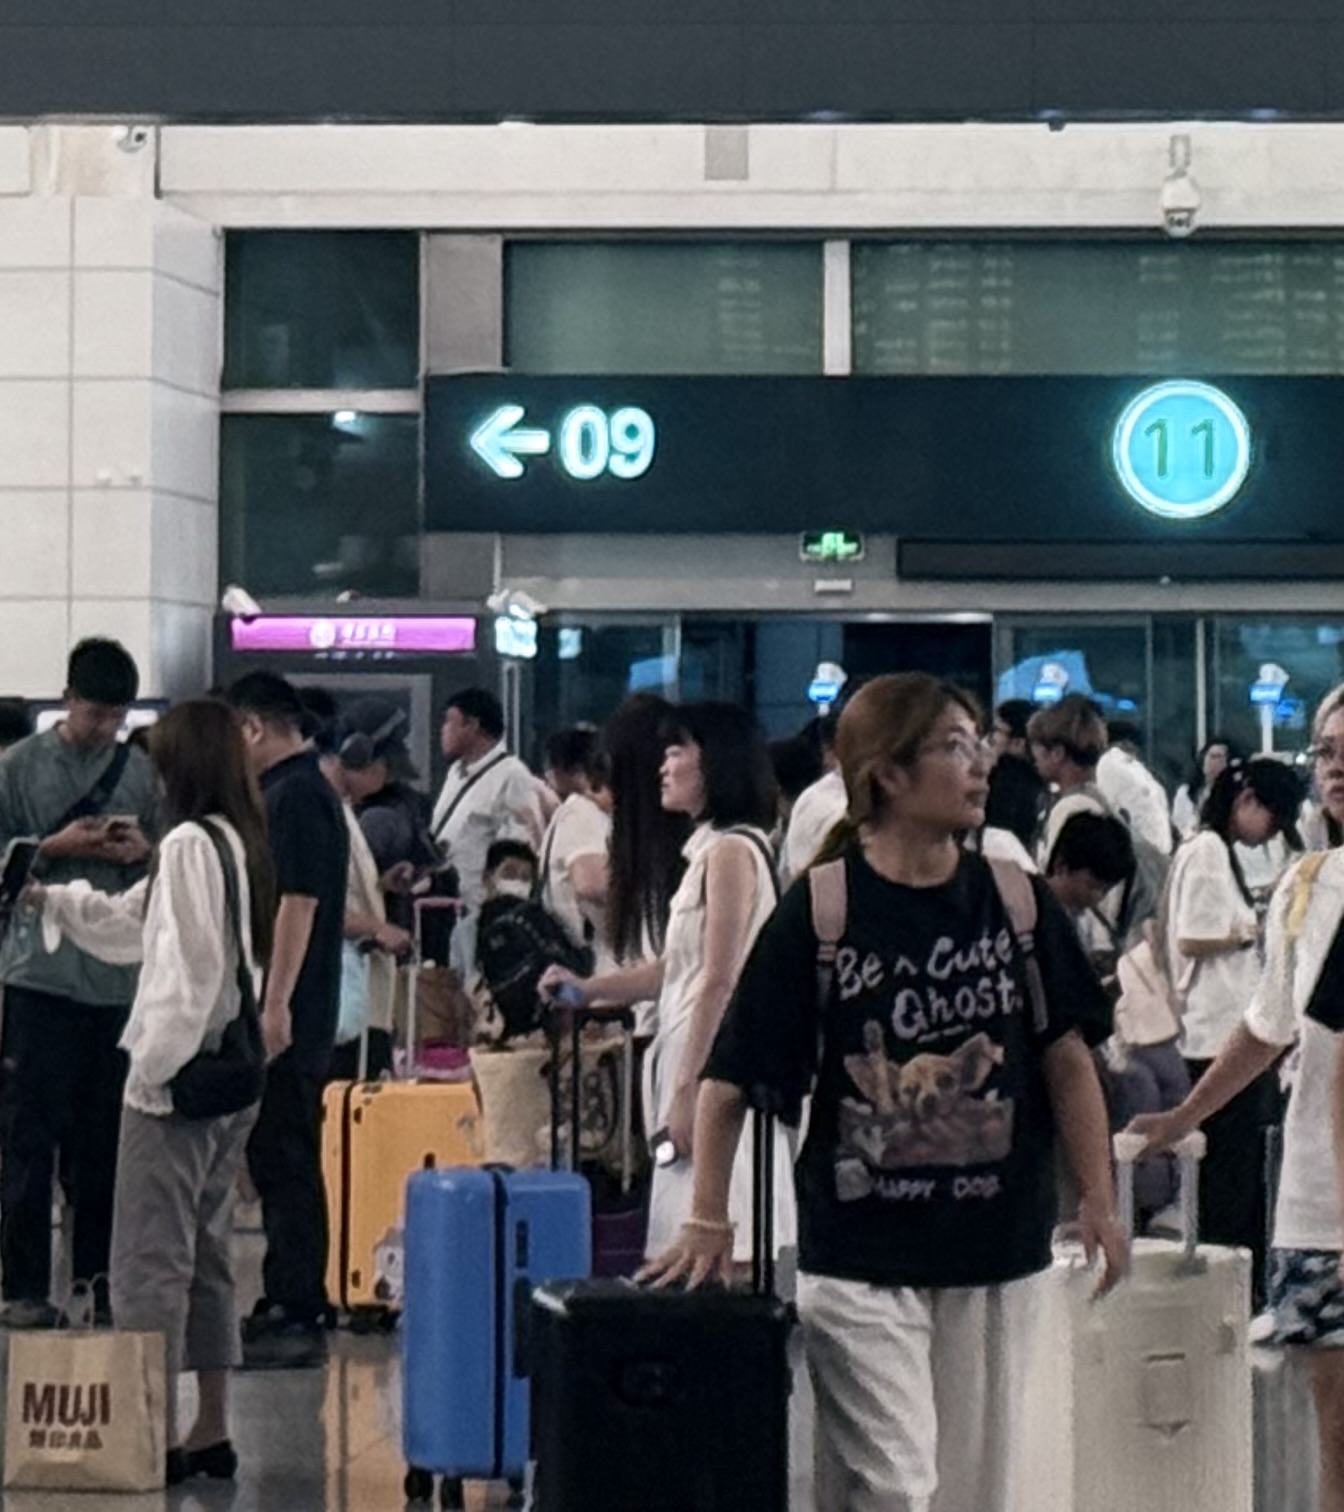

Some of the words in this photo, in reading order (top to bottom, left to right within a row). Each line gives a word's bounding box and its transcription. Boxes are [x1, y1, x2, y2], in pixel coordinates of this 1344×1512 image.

[560, 404, 656, 480] 09
[1143, 416, 1219, 480] 11
[836, 946, 885, 1001] Be
[926, 927, 1014, 980] Cute
[22, 1381, 111, 1427] MUJI
